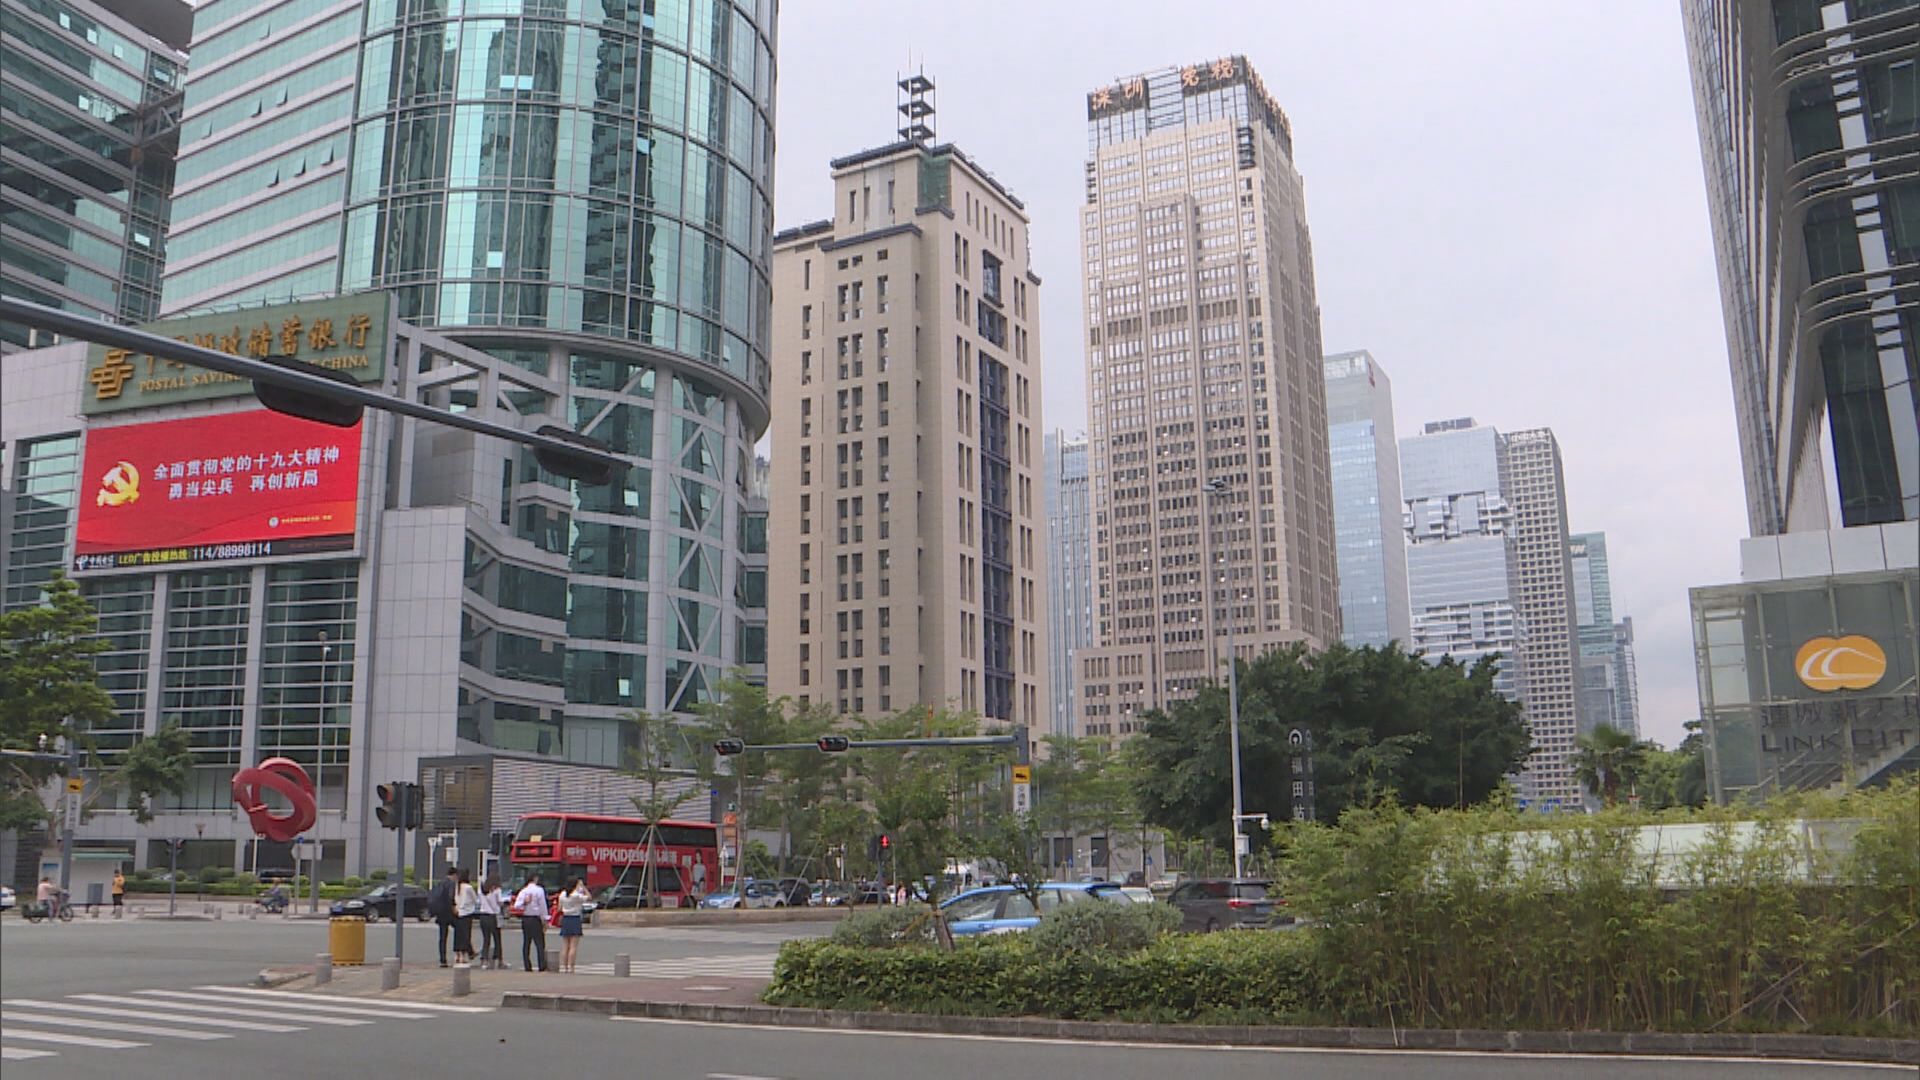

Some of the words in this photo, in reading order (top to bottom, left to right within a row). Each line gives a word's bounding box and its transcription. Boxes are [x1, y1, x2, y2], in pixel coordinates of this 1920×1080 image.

[139, 375, 186, 394] POSTAL
[153, 445, 340, 480] 全面贯彻党的十九大精神
[169, 477, 232, 500] 勇当尖兵
[250, 469, 318, 492] 再创新局
[192, 541, 271, 560] 114/88998114
[1761, 732, 1841, 752] LINK
